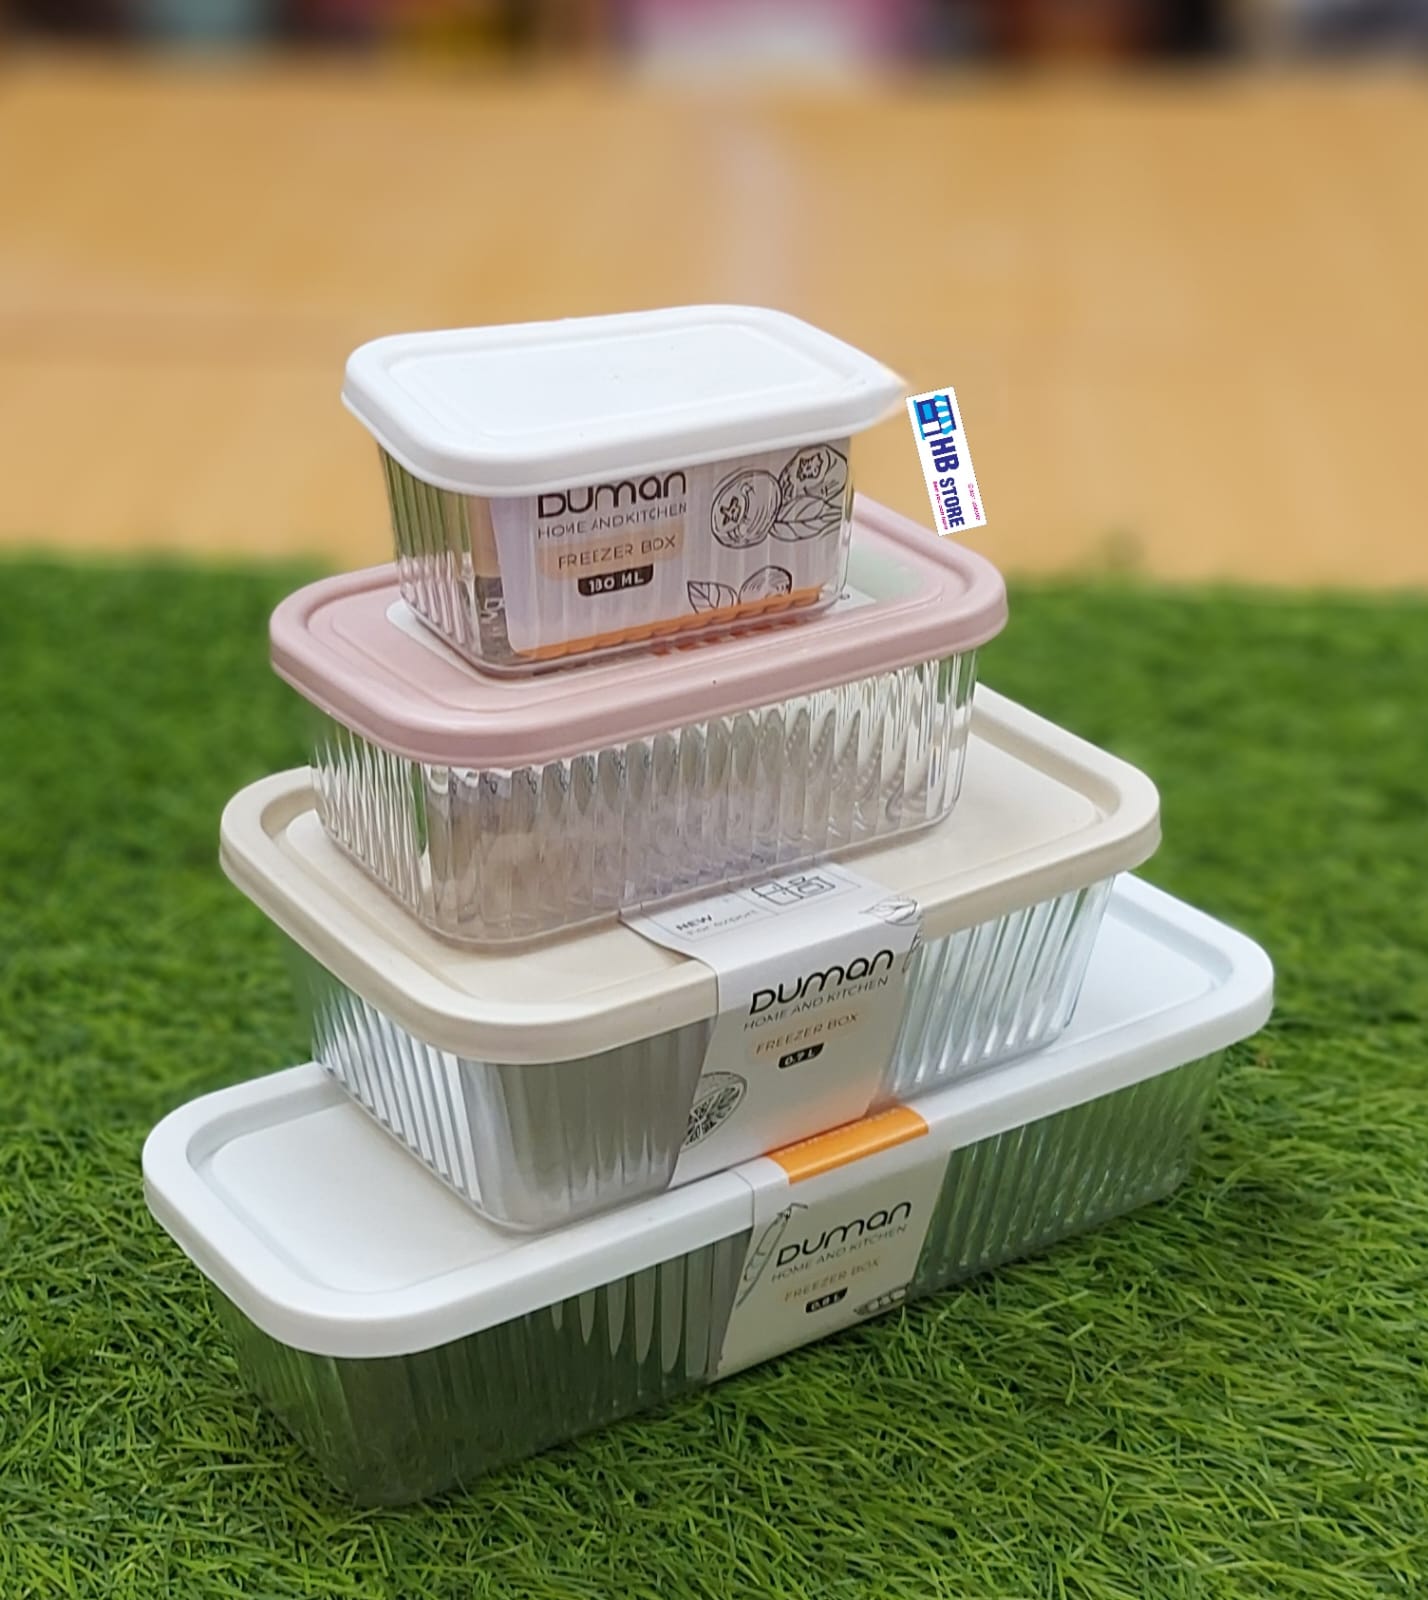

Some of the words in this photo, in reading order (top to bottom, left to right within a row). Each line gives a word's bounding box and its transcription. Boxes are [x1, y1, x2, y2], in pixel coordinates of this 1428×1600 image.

[626, 502, 687, 524] KITCHEN
[558, 544, 633, 570] FREEZER
[641, 535, 676, 555] BOX
[621, 571, 644, 586] ML
[743, 1010, 787, 1032] HOME
[791, 997, 824, 1015] AND
[826, 976, 889, 1003] KITCHEN
[756, 1023, 823, 1055] FREEZER
[827, 1012, 858, 1031] BOX
[771, 1260, 811, 1282] HOME
[816, 1246, 847, 1264] AND
[849, 1223, 908, 1252] KITCHEN
[784, 1269, 848, 1303] FREEZER
